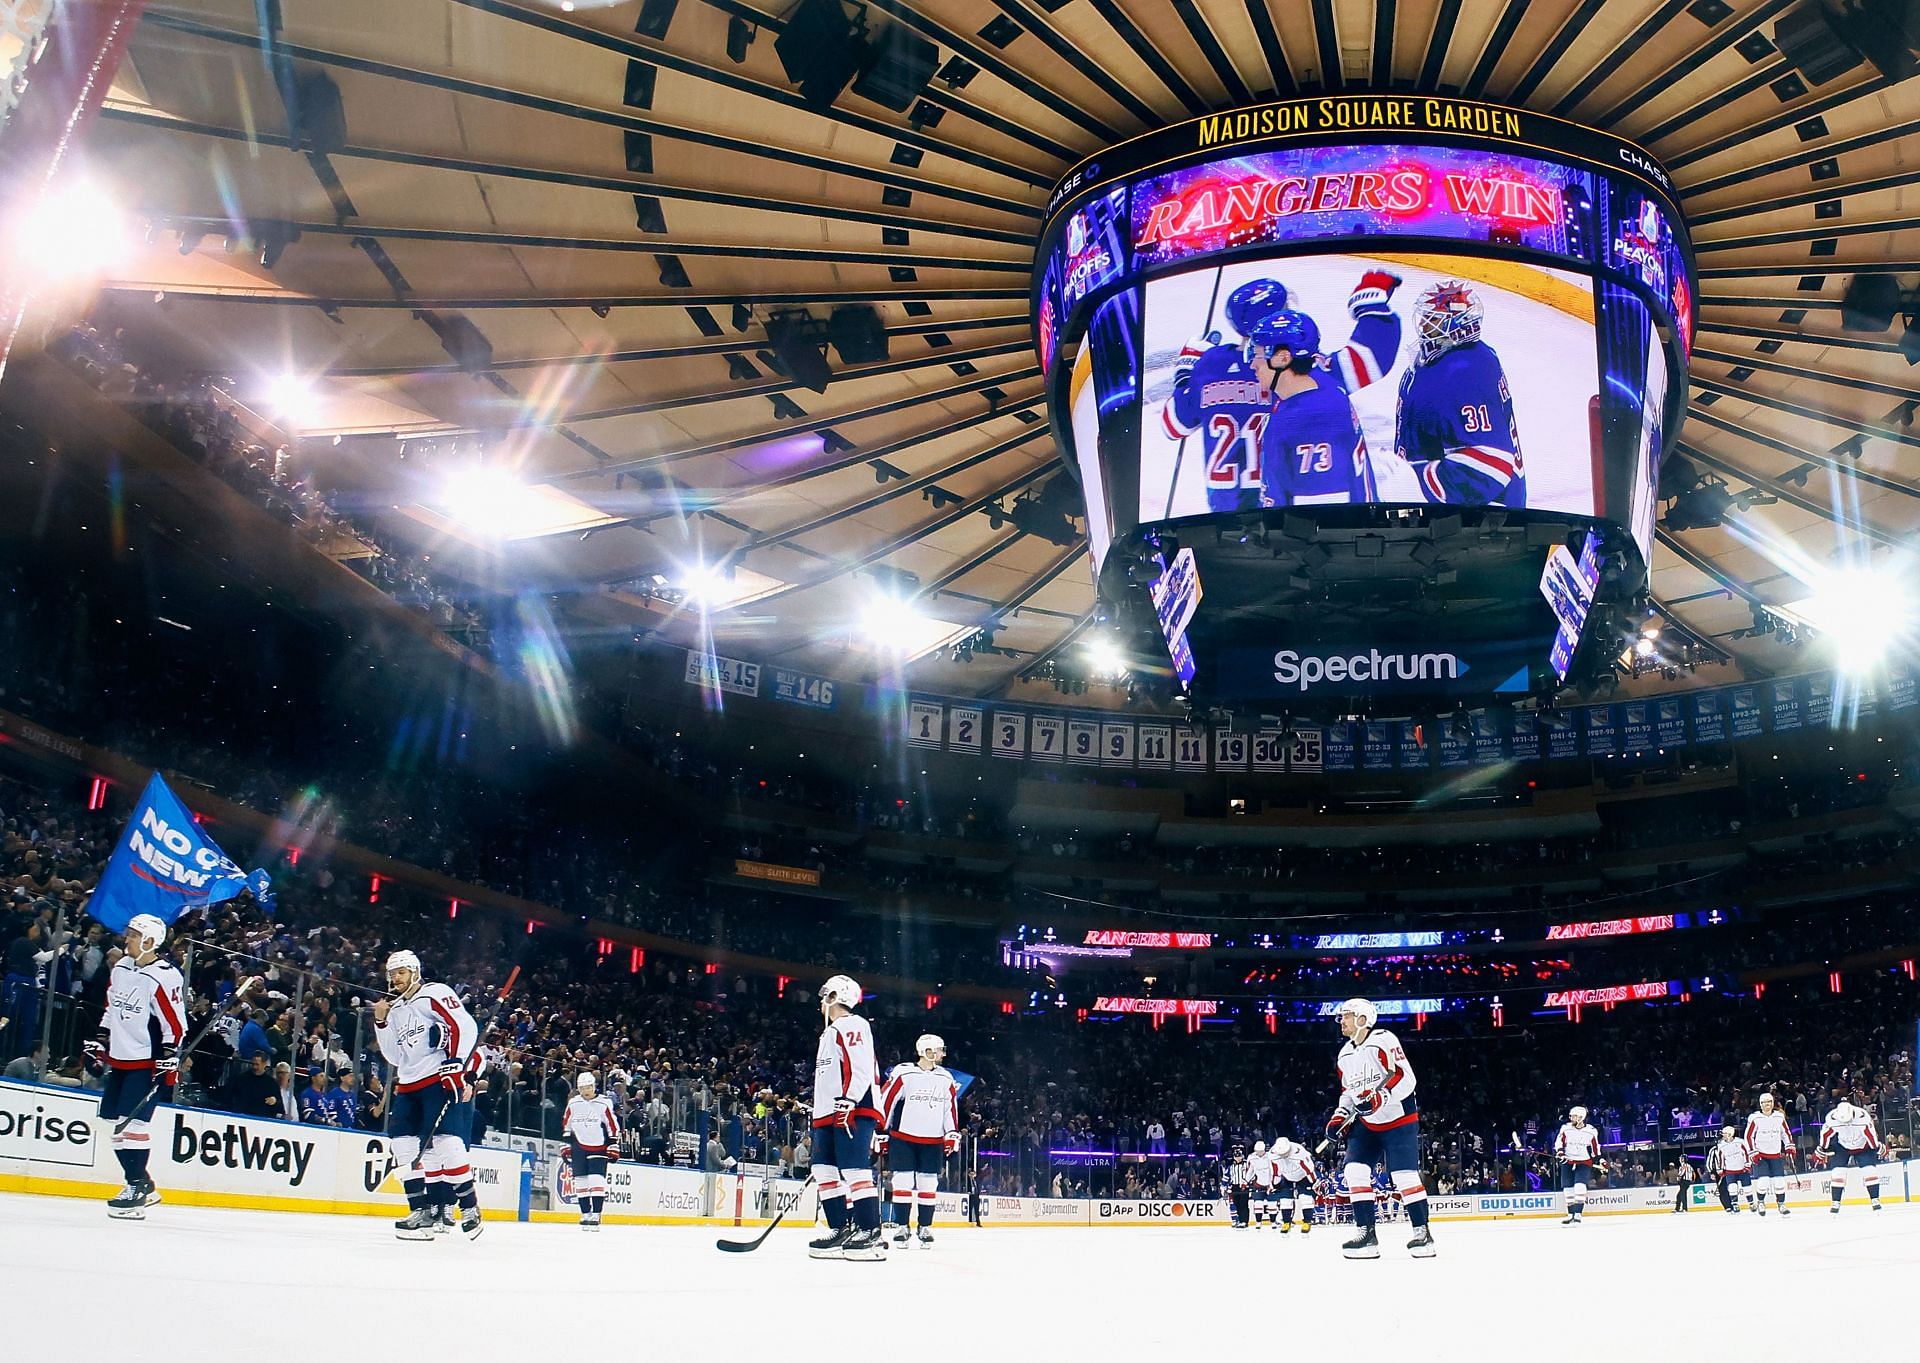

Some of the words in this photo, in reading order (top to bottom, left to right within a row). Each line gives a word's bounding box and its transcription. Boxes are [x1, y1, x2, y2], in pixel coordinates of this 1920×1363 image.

[1620, 148, 1670, 189] CHASE
[1045, 172, 1082, 219] CHASE
[1137, 172, 1422, 247] RANGERS
[1446, 174, 1557, 225] WIN
[1614, 238, 1665, 285] PLAYOFFS
[1461, 404, 1492, 432] 31
[1207, 412, 1263, 489] 21
[1296, 442, 1332, 474] 73
[734, 663, 757, 688] 15
[1274, 649, 1457, 691] Spectrum
[797, 677, 833, 704] 146
[921, 715, 930, 737] 1
[959, 720, 972, 743] 2
[1002, 725, 1016, 747] 3
[1041, 728, 1055, 751] 7
[1077, 733, 1090, 755] 9
[1111, 735, 1124, 757] 9
[1144, 737, 1164, 759] 11
[1181, 740, 1200, 761] 11
[1220, 740, 1243, 761] 19
[1256, 740, 1282, 761] 30
[1292, 740, 1320, 762] 35
[142, 807, 192, 856] NO
[130, 830, 211, 888] NEW
[1083, 930, 1170, 947] RANGERS
[1177, 932, 1211, 947] WIN
[1546, 920, 1632, 940] RANGERS
[1638, 915, 1673, 930] WIN
[1315, 933, 1402, 949] RANGERS
[1408, 931, 1443, 947] WIN
[442, 996, 460, 1009] 26
[1093, 997, 1176, 1013] RANGERS
[1183, 999, 1217, 1013] WIN
[1544, 986, 1627, 1007] RANGERS
[1633, 981, 1667, 997] WIN
[1408, 998, 1443, 1013] WIN
[846, 1032, 864, 1047] 24
[172, 1113, 315, 1187] betway
[1085, 1158, 1110, 1166] ULTRA
[616, 1170, 632, 1186] sub
[604, 1185, 632, 1205] above
[996, 1198, 1021, 1210] HONDA
[1481, 1198, 1510, 1210] BUD
[1512, 1197, 1553, 1209] LIGHT
[1138, 1203, 1213, 1217] DISCOVER
